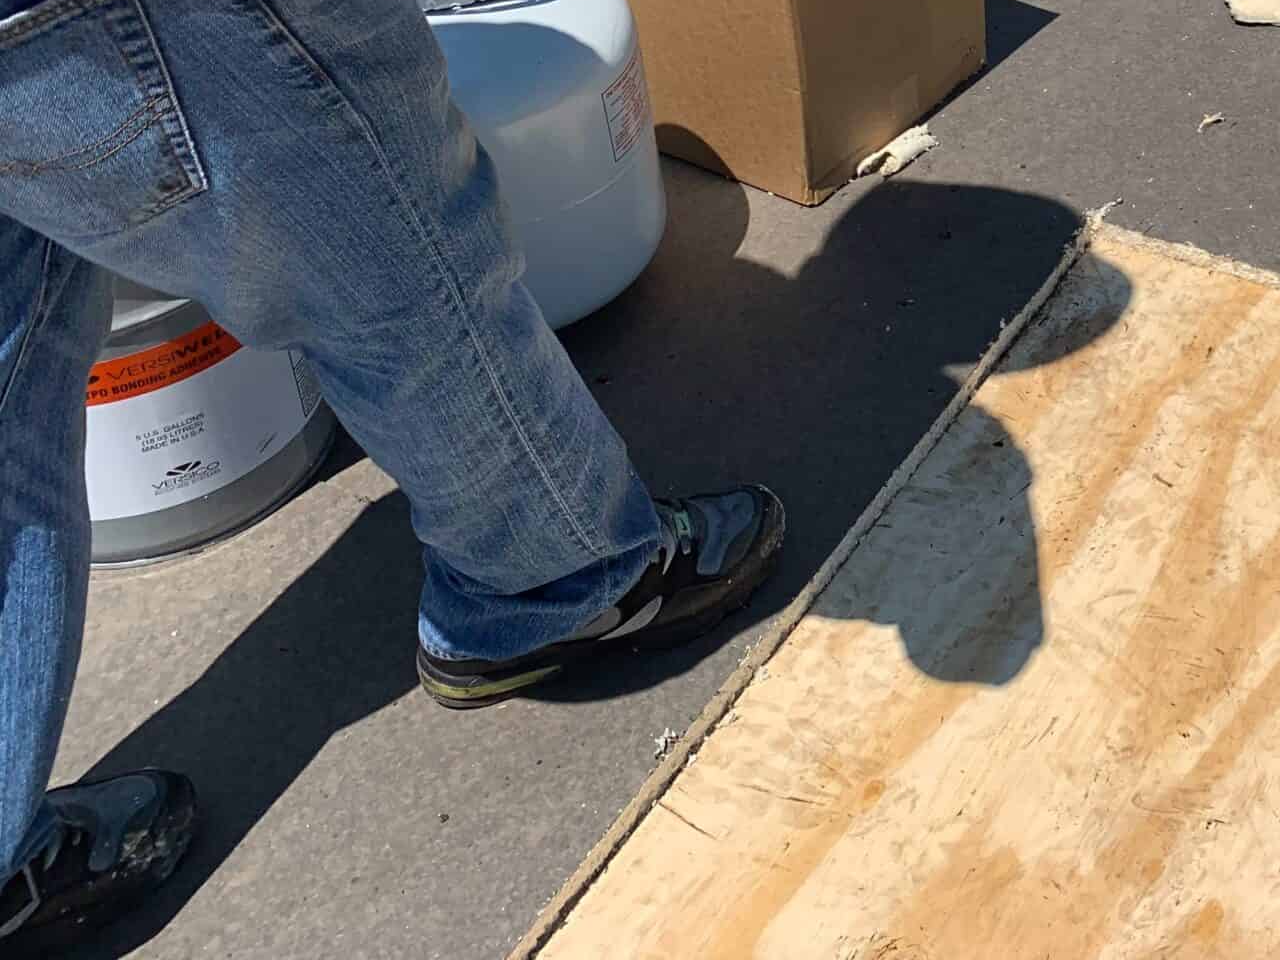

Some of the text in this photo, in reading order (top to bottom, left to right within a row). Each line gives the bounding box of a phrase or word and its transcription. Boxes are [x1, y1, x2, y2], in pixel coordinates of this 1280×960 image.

[106, 327, 228, 380] VERSIWEL
[112, 374, 167, 395] BONDING
[169, 345, 223, 375] ADHESIVE
[163, 412, 205, 432] GALLONS
[141, 441, 168, 453] MADE
[152, 460, 220, 489] VERSICO
